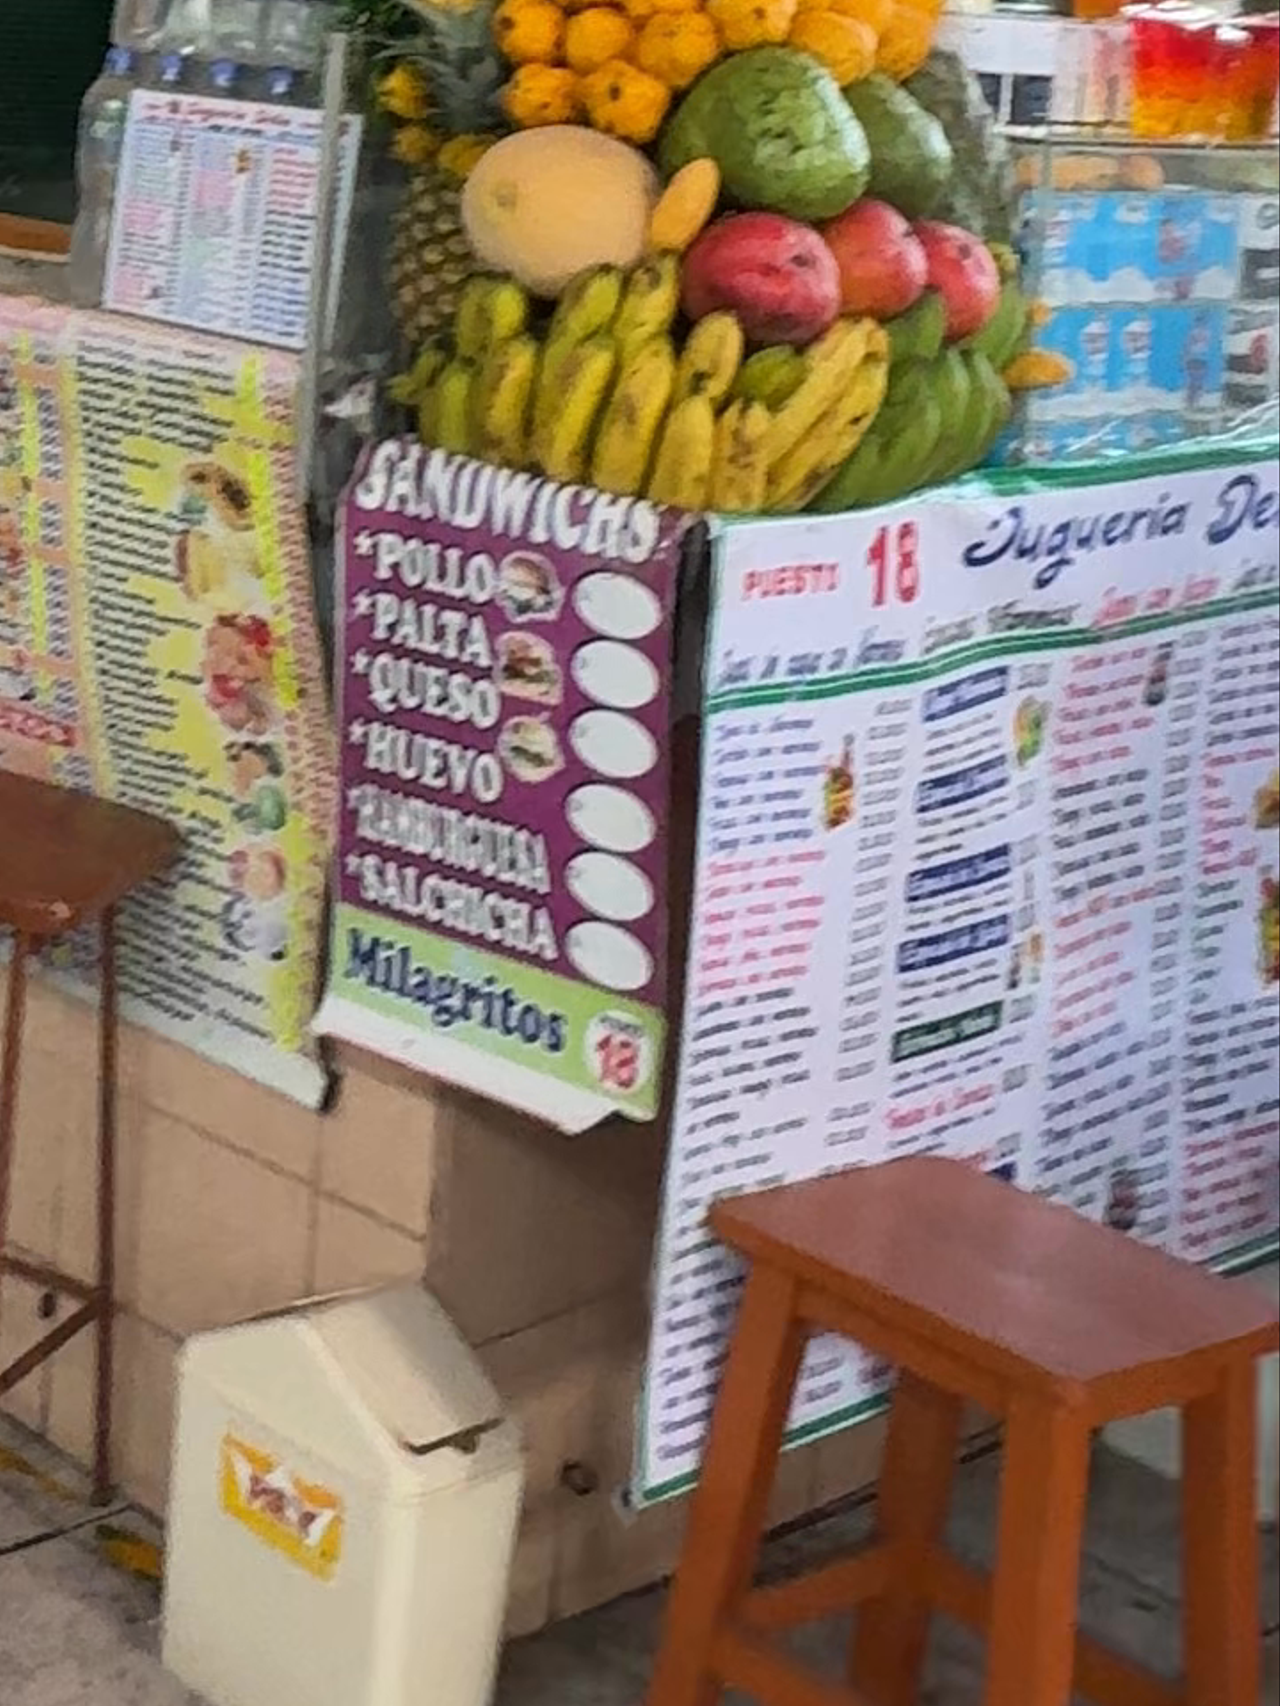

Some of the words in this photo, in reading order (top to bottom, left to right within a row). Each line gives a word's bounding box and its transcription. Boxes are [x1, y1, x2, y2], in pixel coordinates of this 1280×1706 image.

[372, 532, 499, 604] POLLO
[865, 520, 919, 607] 18
[372, 591, 493, 669] PALTA
[369, 652, 501, 729] QUESO
[343, 927, 568, 1053] Milagritos
